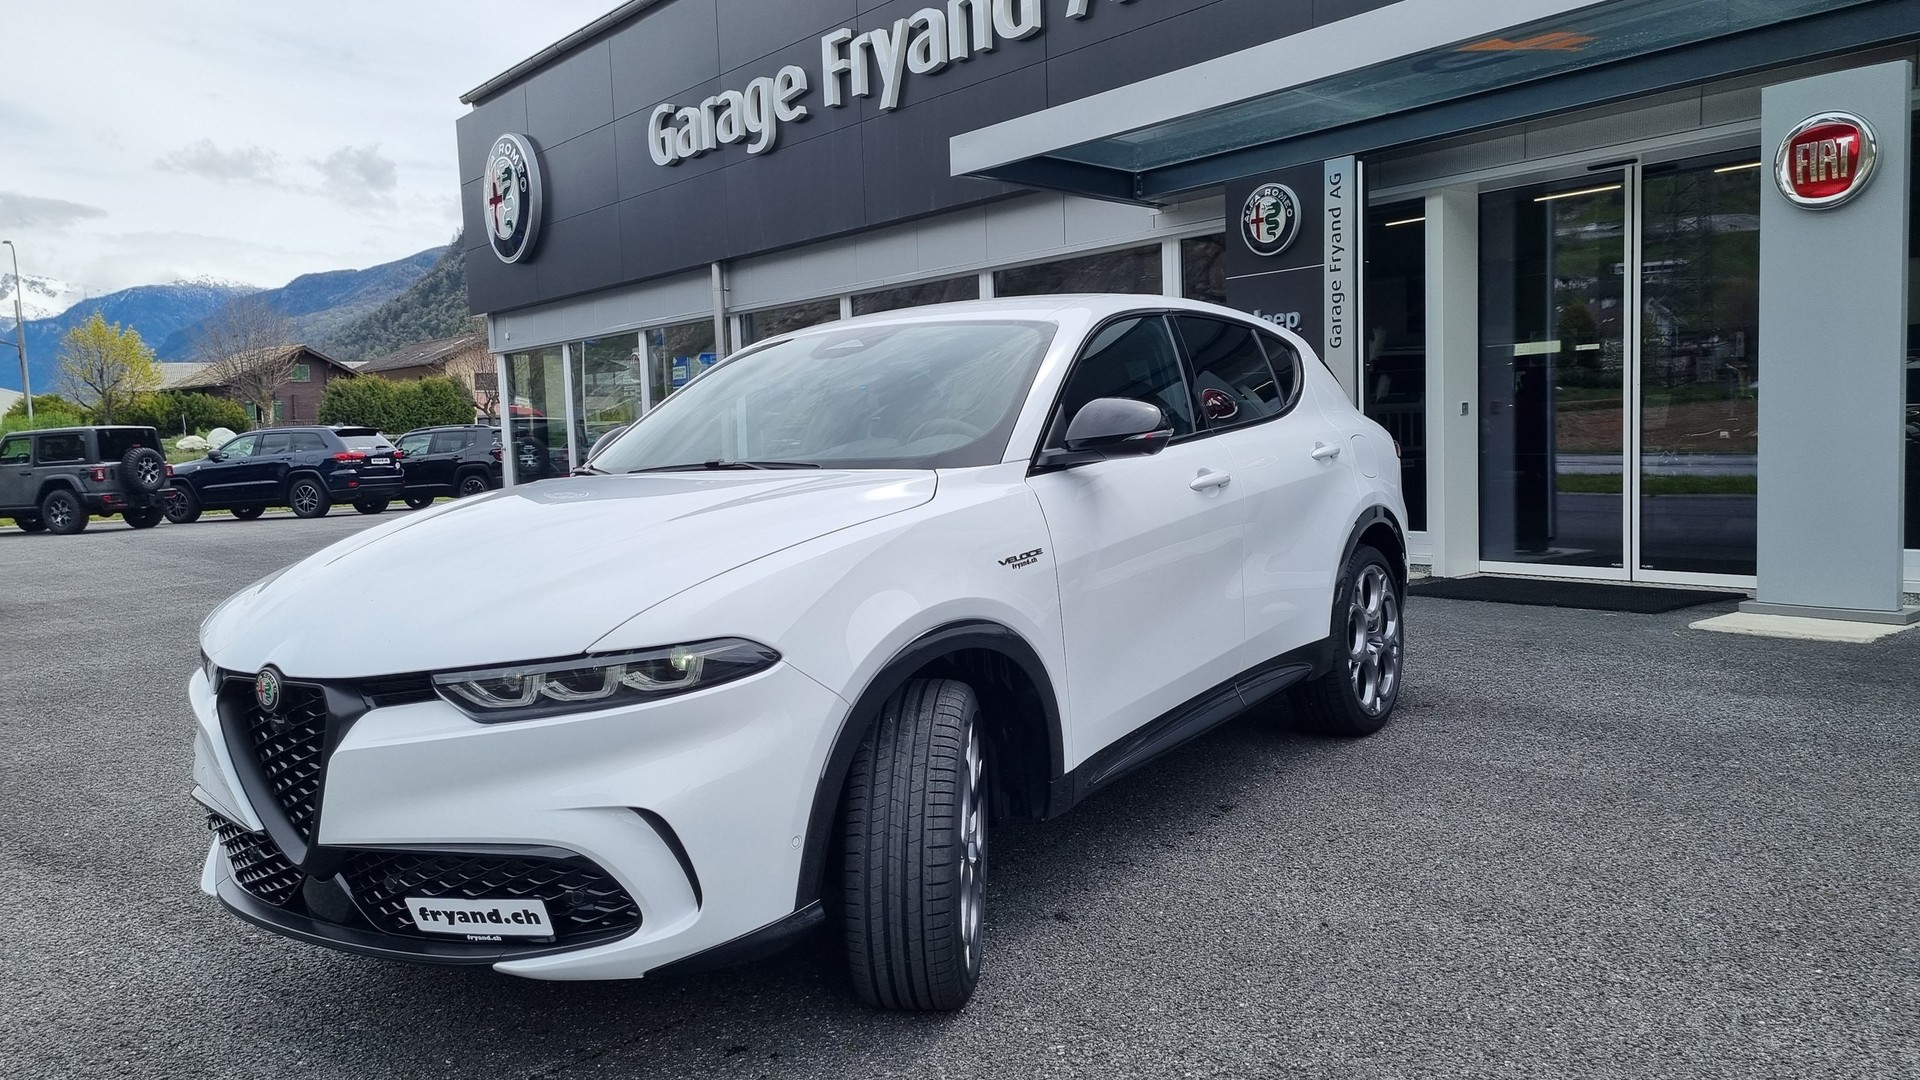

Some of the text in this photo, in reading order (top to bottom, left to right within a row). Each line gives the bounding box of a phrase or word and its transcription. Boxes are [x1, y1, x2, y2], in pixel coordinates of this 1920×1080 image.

[648, 65, 808, 166] Garage
[1796, 135, 1855, 185] FIAT
[1244, 188, 1293, 223] ALFA ROMEO
[1328, 172, 1345, 348] Garage Fryand AG
[998, 548, 1043, 565] VELOCE
[419, 907, 541, 925] fryand.ch
